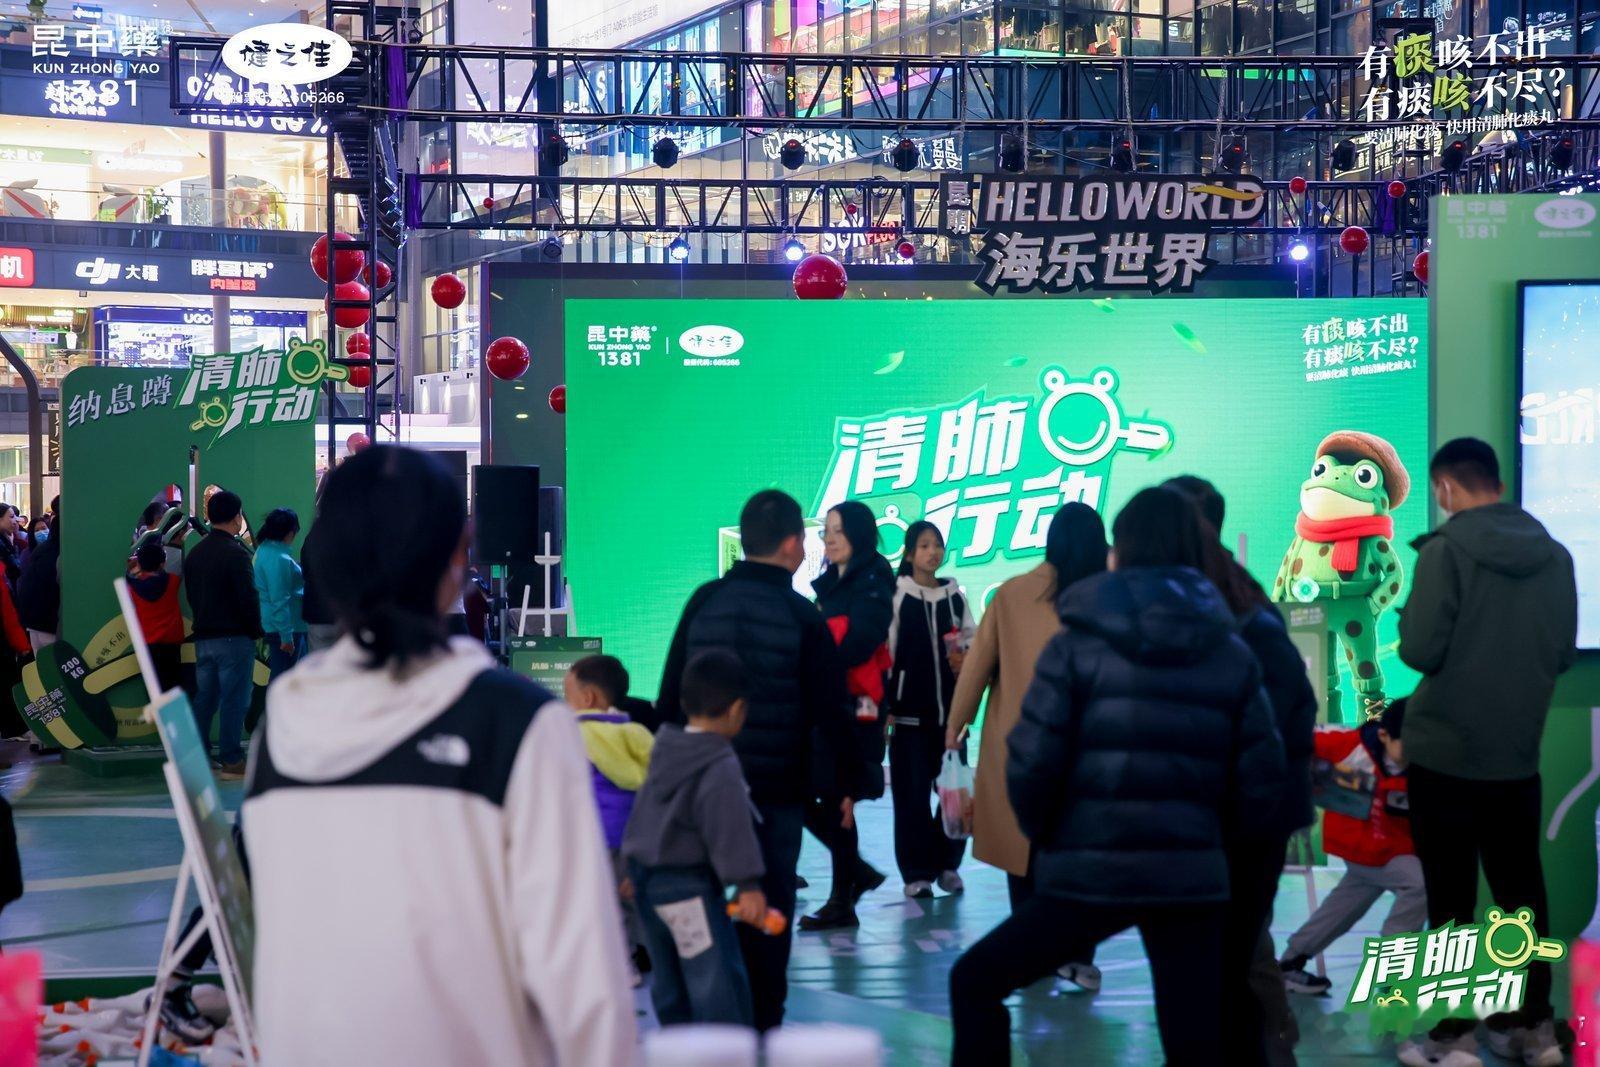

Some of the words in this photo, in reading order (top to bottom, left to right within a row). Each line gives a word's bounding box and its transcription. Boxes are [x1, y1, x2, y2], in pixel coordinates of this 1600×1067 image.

[986, 181, 1109, 221] HELLO
[1116, 181, 1265, 221] WORLD
[985, 231, 1207, 289] 海乐世界
[1302, 313, 1409, 345] 有痰咳不出
[598, 351, 641, 366] 1381
[1304, 336, 1419, 369] 有痰咳不尽?
[179, 352, 283, 406] 清肺
[67, 374, 172, 428] 纳息蹲
[217, 384, 315, 439] 行动
[816, 398, 1028, 519] 清肺
[61, 657, 80, 674] 200
[71, 667, 85, 680] KG
[39, 705, 66, 725] 1381
